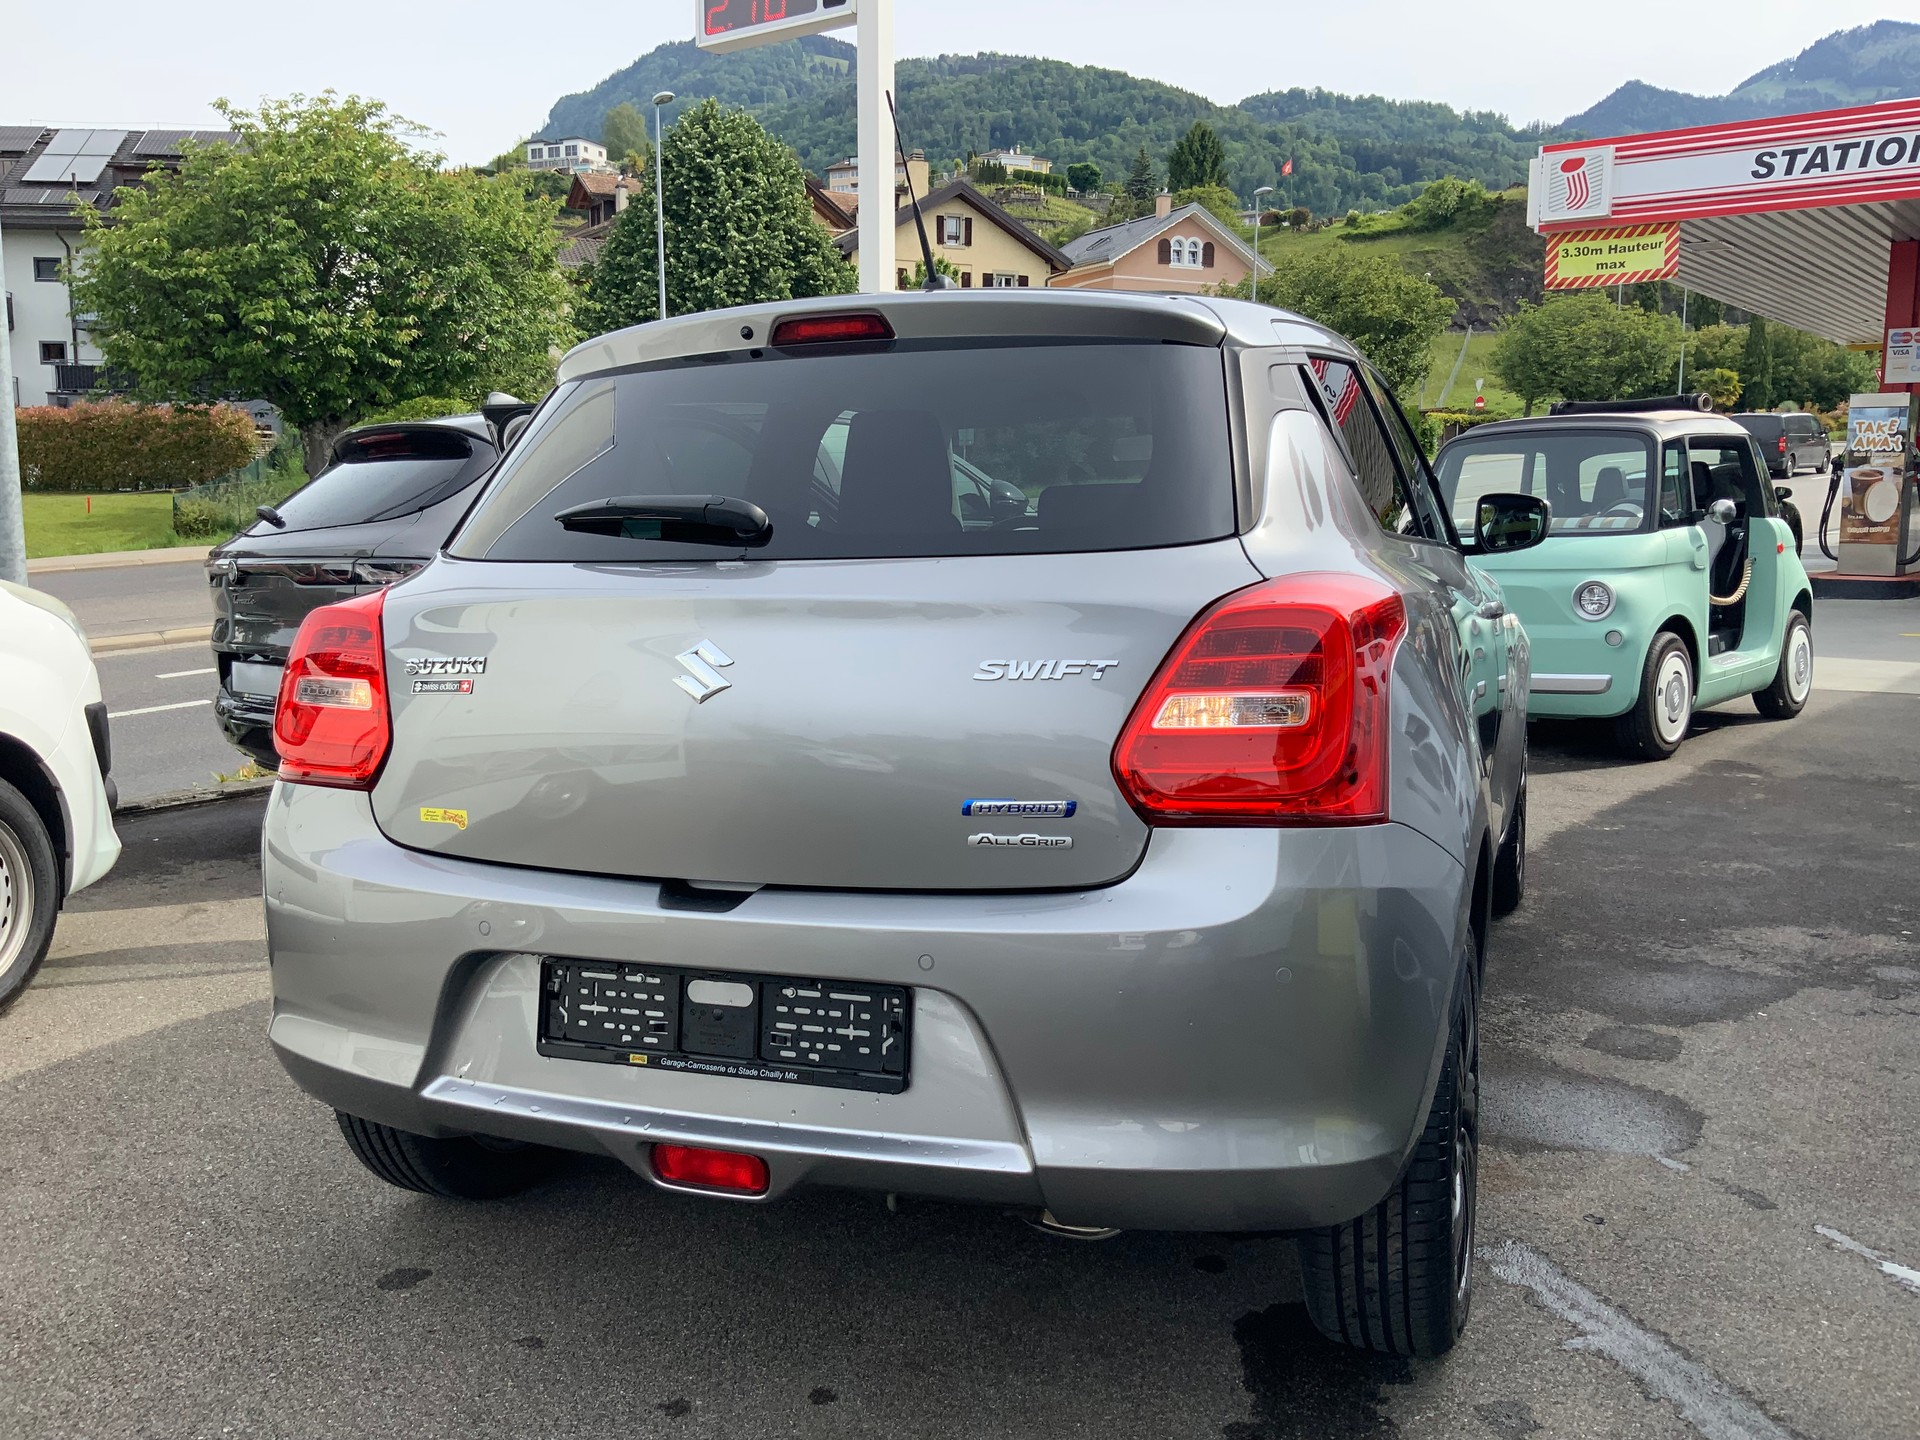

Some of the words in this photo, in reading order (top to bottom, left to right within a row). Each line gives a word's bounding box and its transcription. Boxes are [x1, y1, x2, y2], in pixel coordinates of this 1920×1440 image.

[1562, 246, 1603, 258] 3.30m
[1608, 240, 1664, 255] Hauteur
[1596, 260, 1626, 270] max
[1855, 418, 1899, 435] TAKE
[1852, 436, 1902, 451] AWAY
[404, 656, 487, 675] SUZUKI
[973, 659, 1120, 681] SWIFT
[422, 682, 439, 691] swiss
[439, 681, 460, 691] edition
[978, 804, 1062, 815] HYBRID
[660, 1057, 726, 1073] Garage-Carrosserie
[727, 1066, 737, 1074] du
[737, 1066, 758, 1077] Stade
